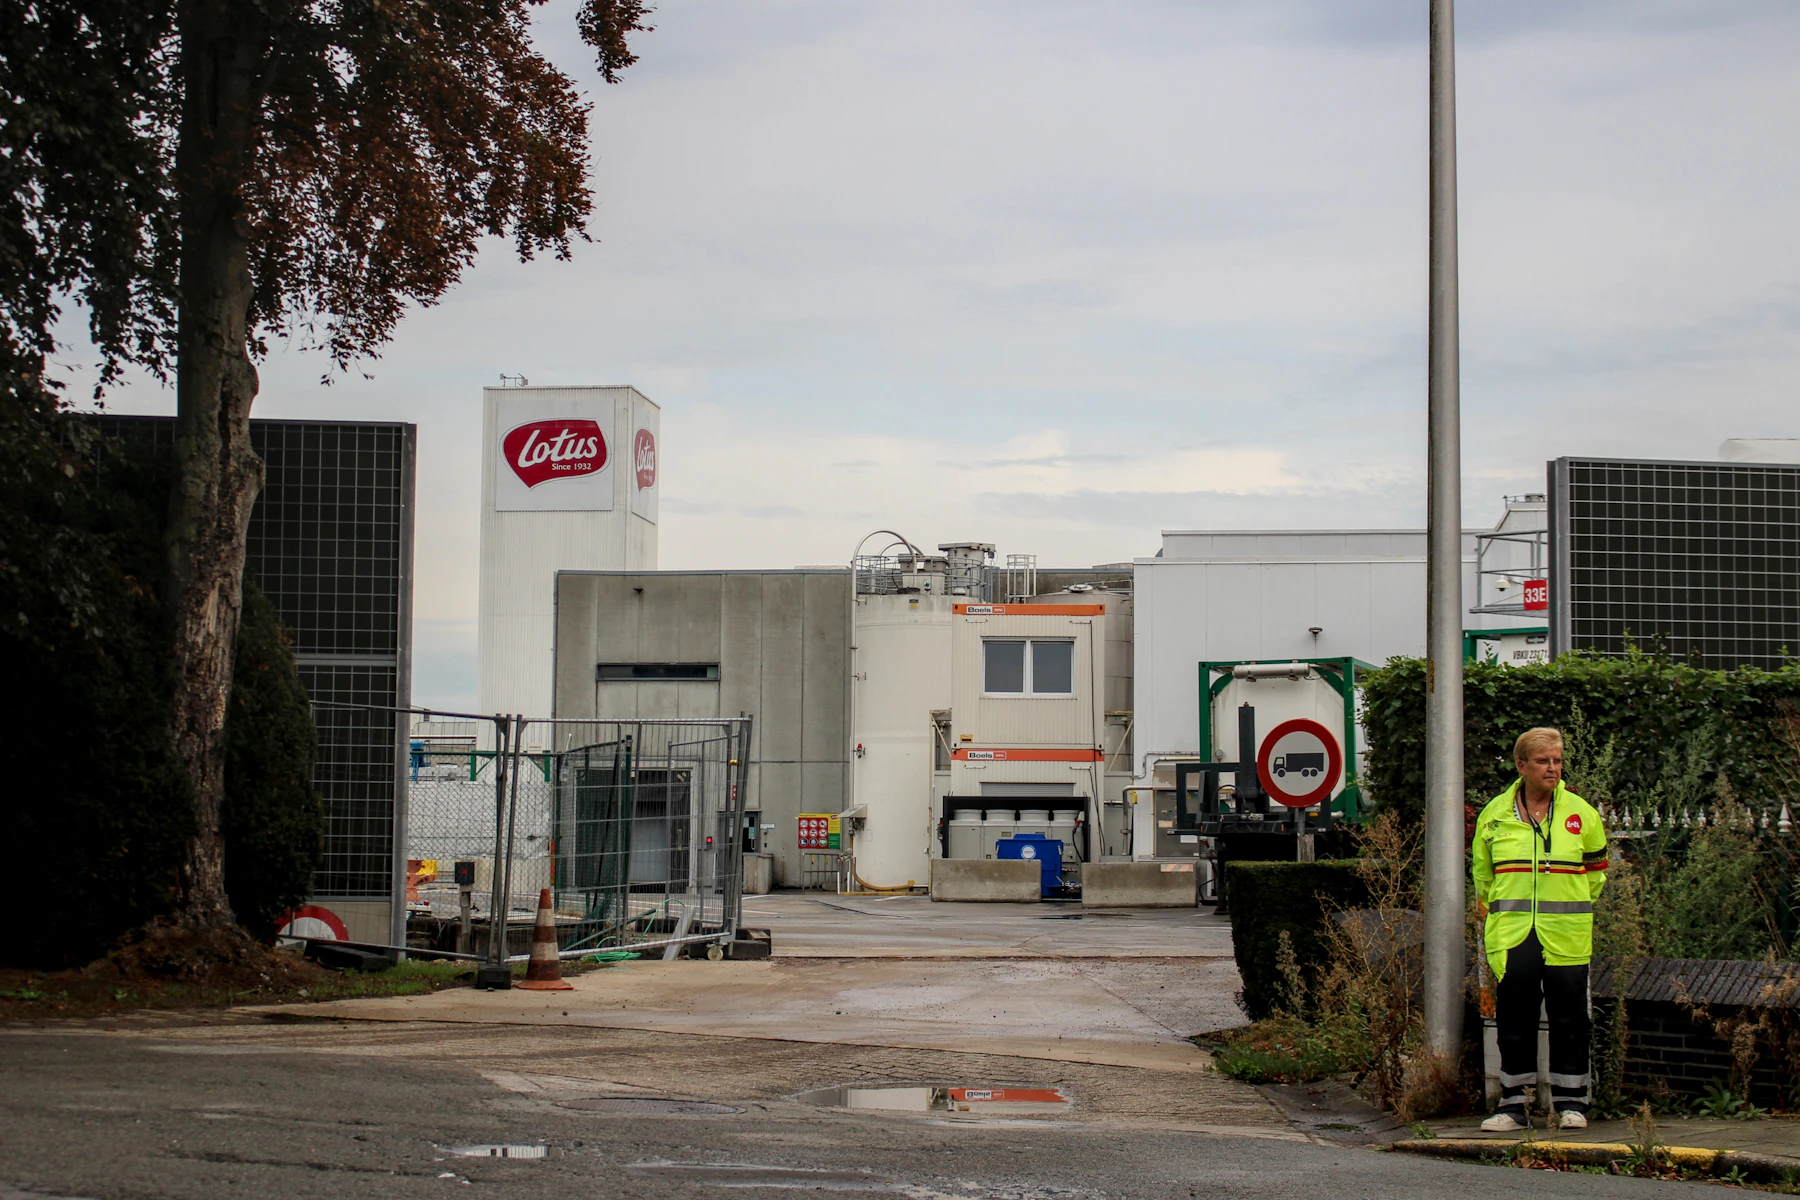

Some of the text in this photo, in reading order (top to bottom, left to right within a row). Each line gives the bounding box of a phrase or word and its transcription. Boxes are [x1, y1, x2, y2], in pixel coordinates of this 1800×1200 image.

[518, 429, 598, 468] Lotus
[551, 463, 572, 471] Since
[1525, 587, 1546, 603] 33E
